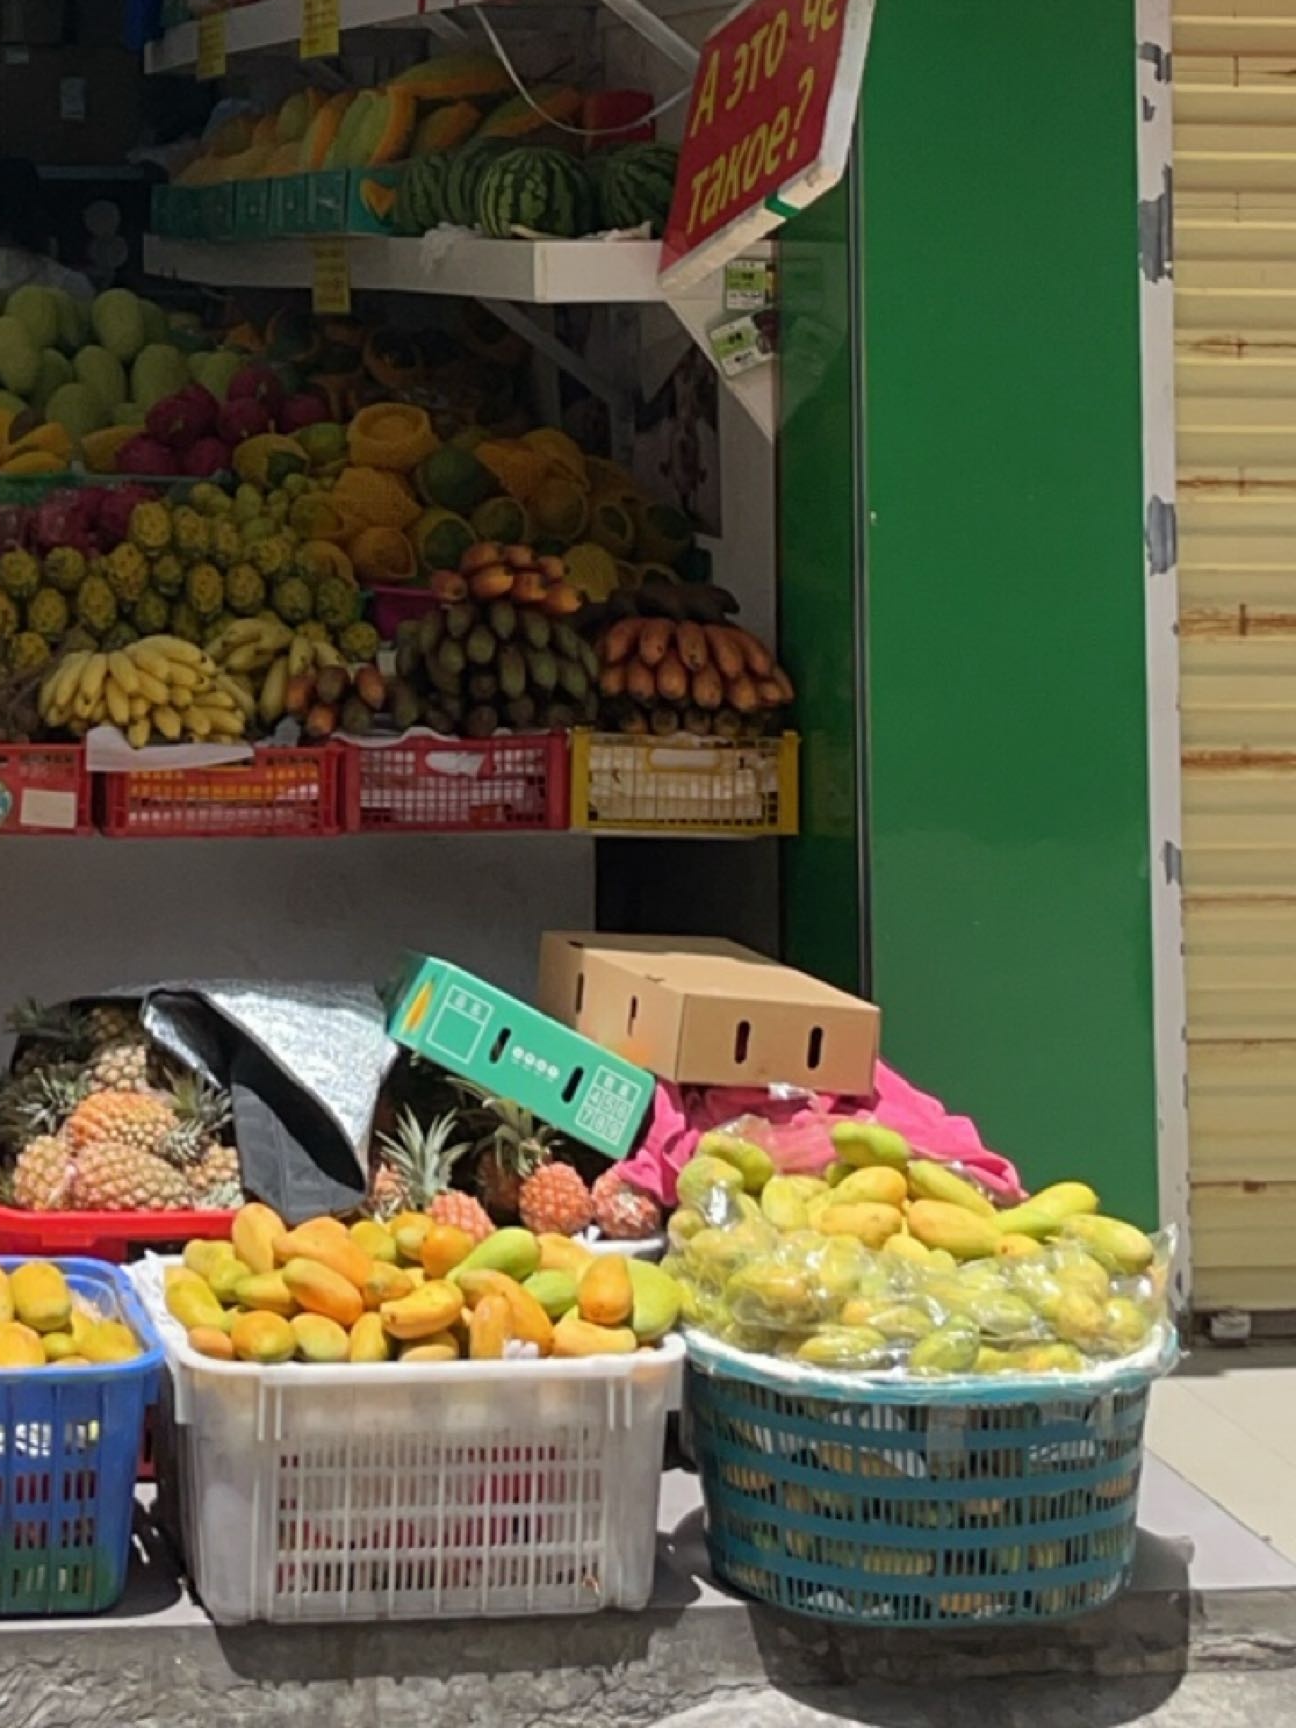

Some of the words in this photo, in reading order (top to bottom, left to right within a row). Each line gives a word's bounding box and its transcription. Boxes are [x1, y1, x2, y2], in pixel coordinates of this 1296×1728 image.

[690, 47, 721, 138] А
[725, 9, 787, 111] это
[686, 67, 814, 234] такое?
